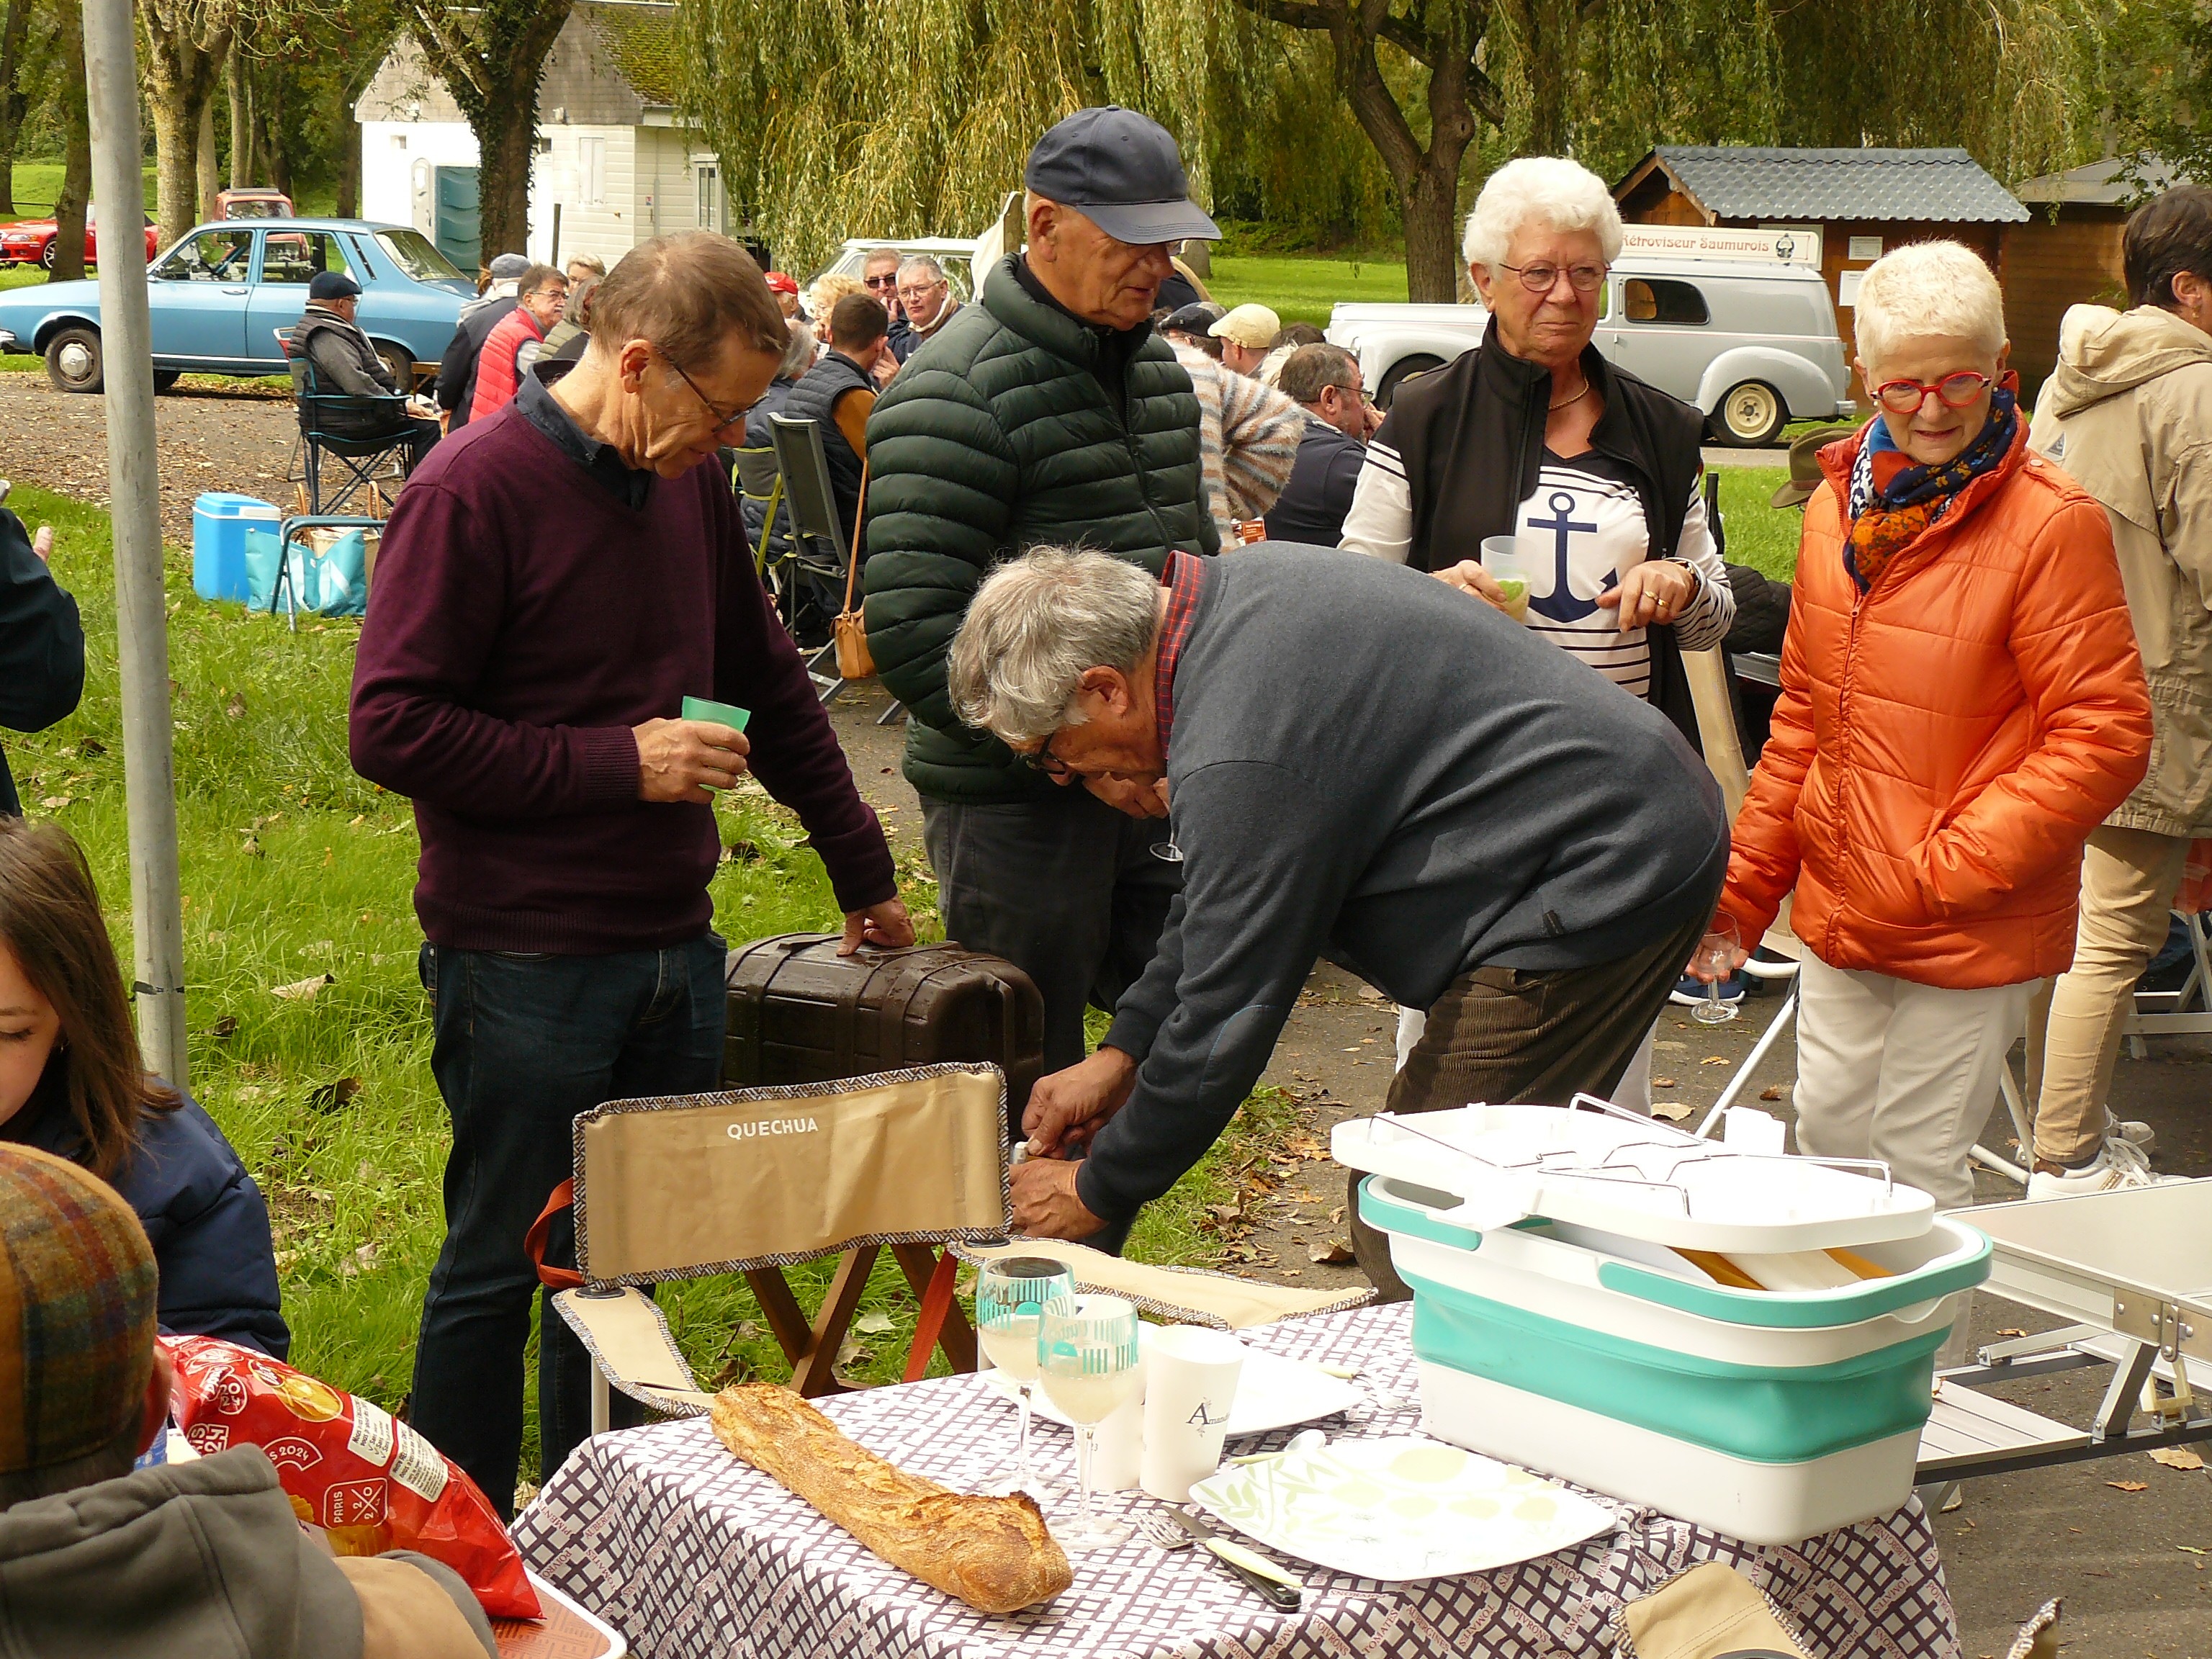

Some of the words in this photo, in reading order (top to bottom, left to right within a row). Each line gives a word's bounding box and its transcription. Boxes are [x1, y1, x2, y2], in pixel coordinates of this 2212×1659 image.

[1622, 234, 1696, 248] Rétroviseur
[1700, 235, 1769, 251] Saumurois
[727, 1118, 819, 1140] QUECHUA
[279, 1446, 310, 1461] 2024
[333, 1491, 343, 1524] PARIS
[1671, 1527, 1686, 1568] PIMENTS
[586, 1549, 616, 1592] TOMATES
[1826, 1581, 1864, 1618] AUBERGINES
[1873, 1576, 1910, 1614] TOMATES
[1313, 1617, 1349, 1656] POIVRONS
[1362, 1609, 1398, 1654] TOMATES
[1406, 1606, 1450, 1652] AUBERGINES
[1459, 1604, 1495, 1647] TOMATES
[1508, 1604, 1549, 1643] POIVRONS
[1560, 1596, 1593, 1641] TOMATES
